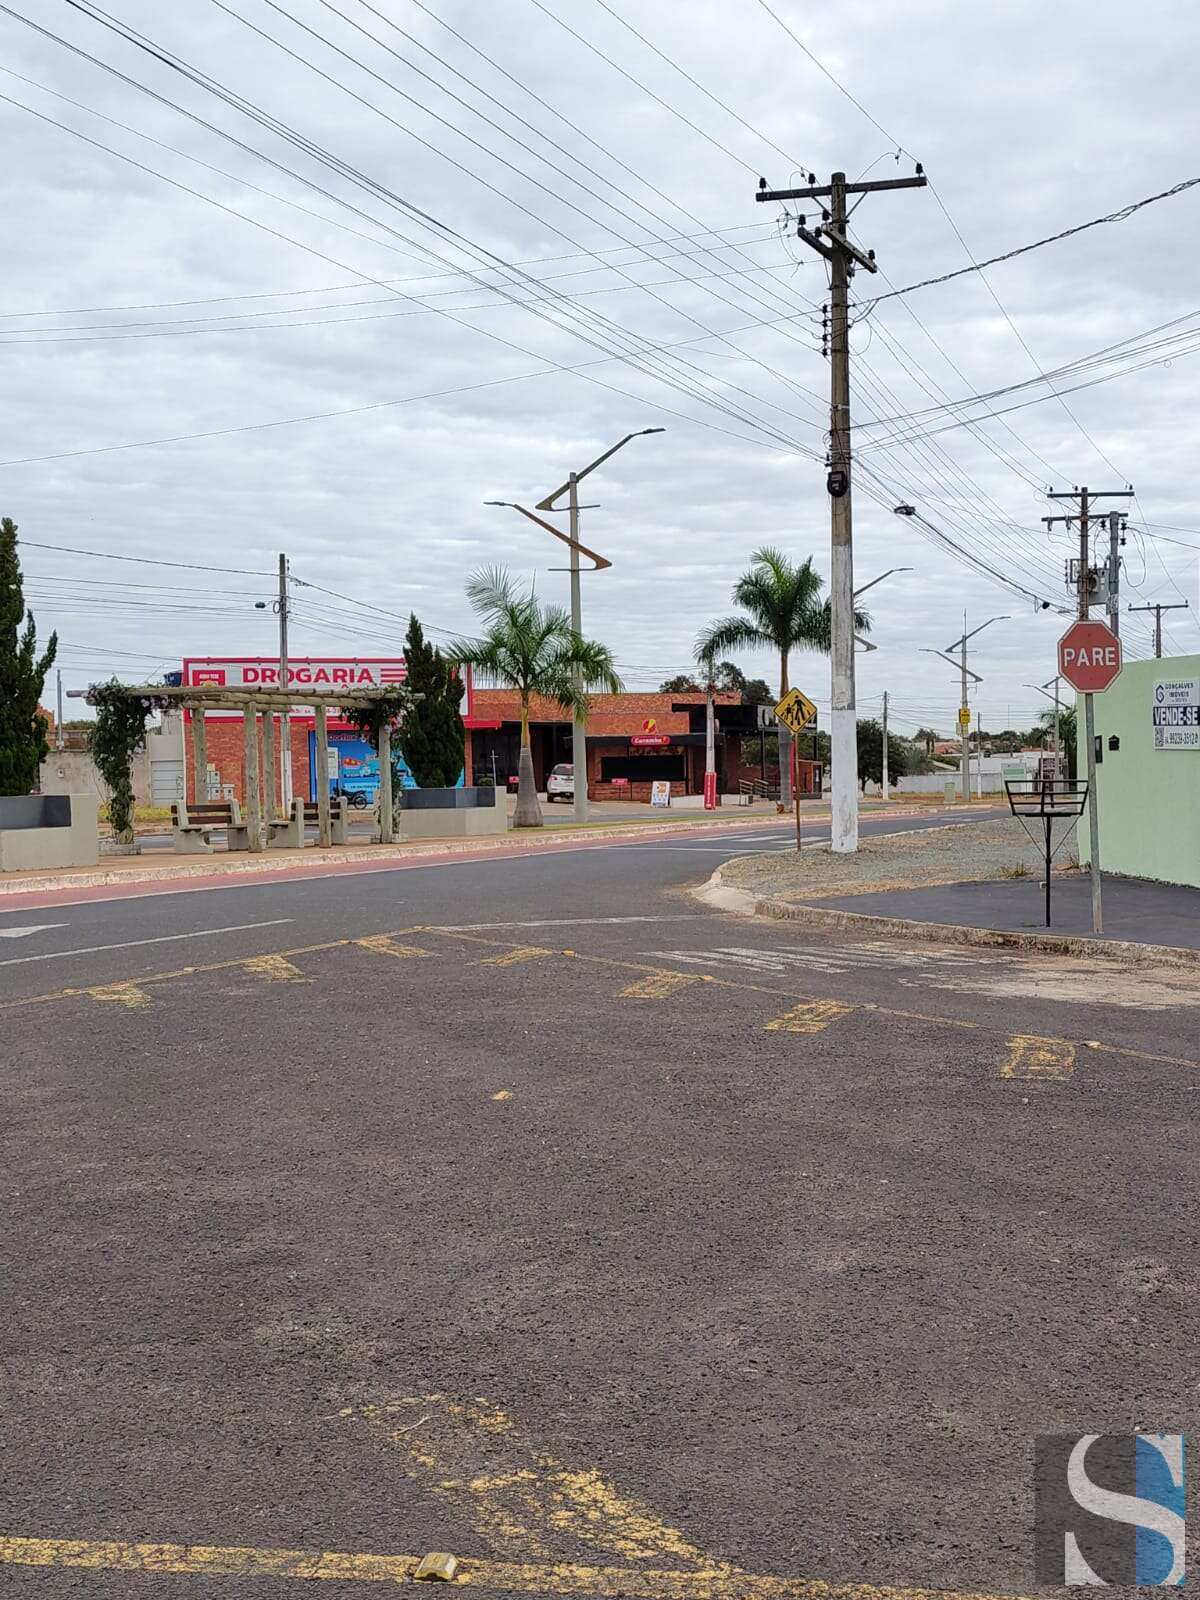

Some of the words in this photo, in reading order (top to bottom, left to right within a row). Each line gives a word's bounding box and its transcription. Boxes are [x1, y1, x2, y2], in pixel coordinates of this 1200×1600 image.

[1063, 647, 1117, 667] PARE
[242, 667, 374, 684] DROGARIA
[1154, 707, 1198, 726] VENDE-SE
